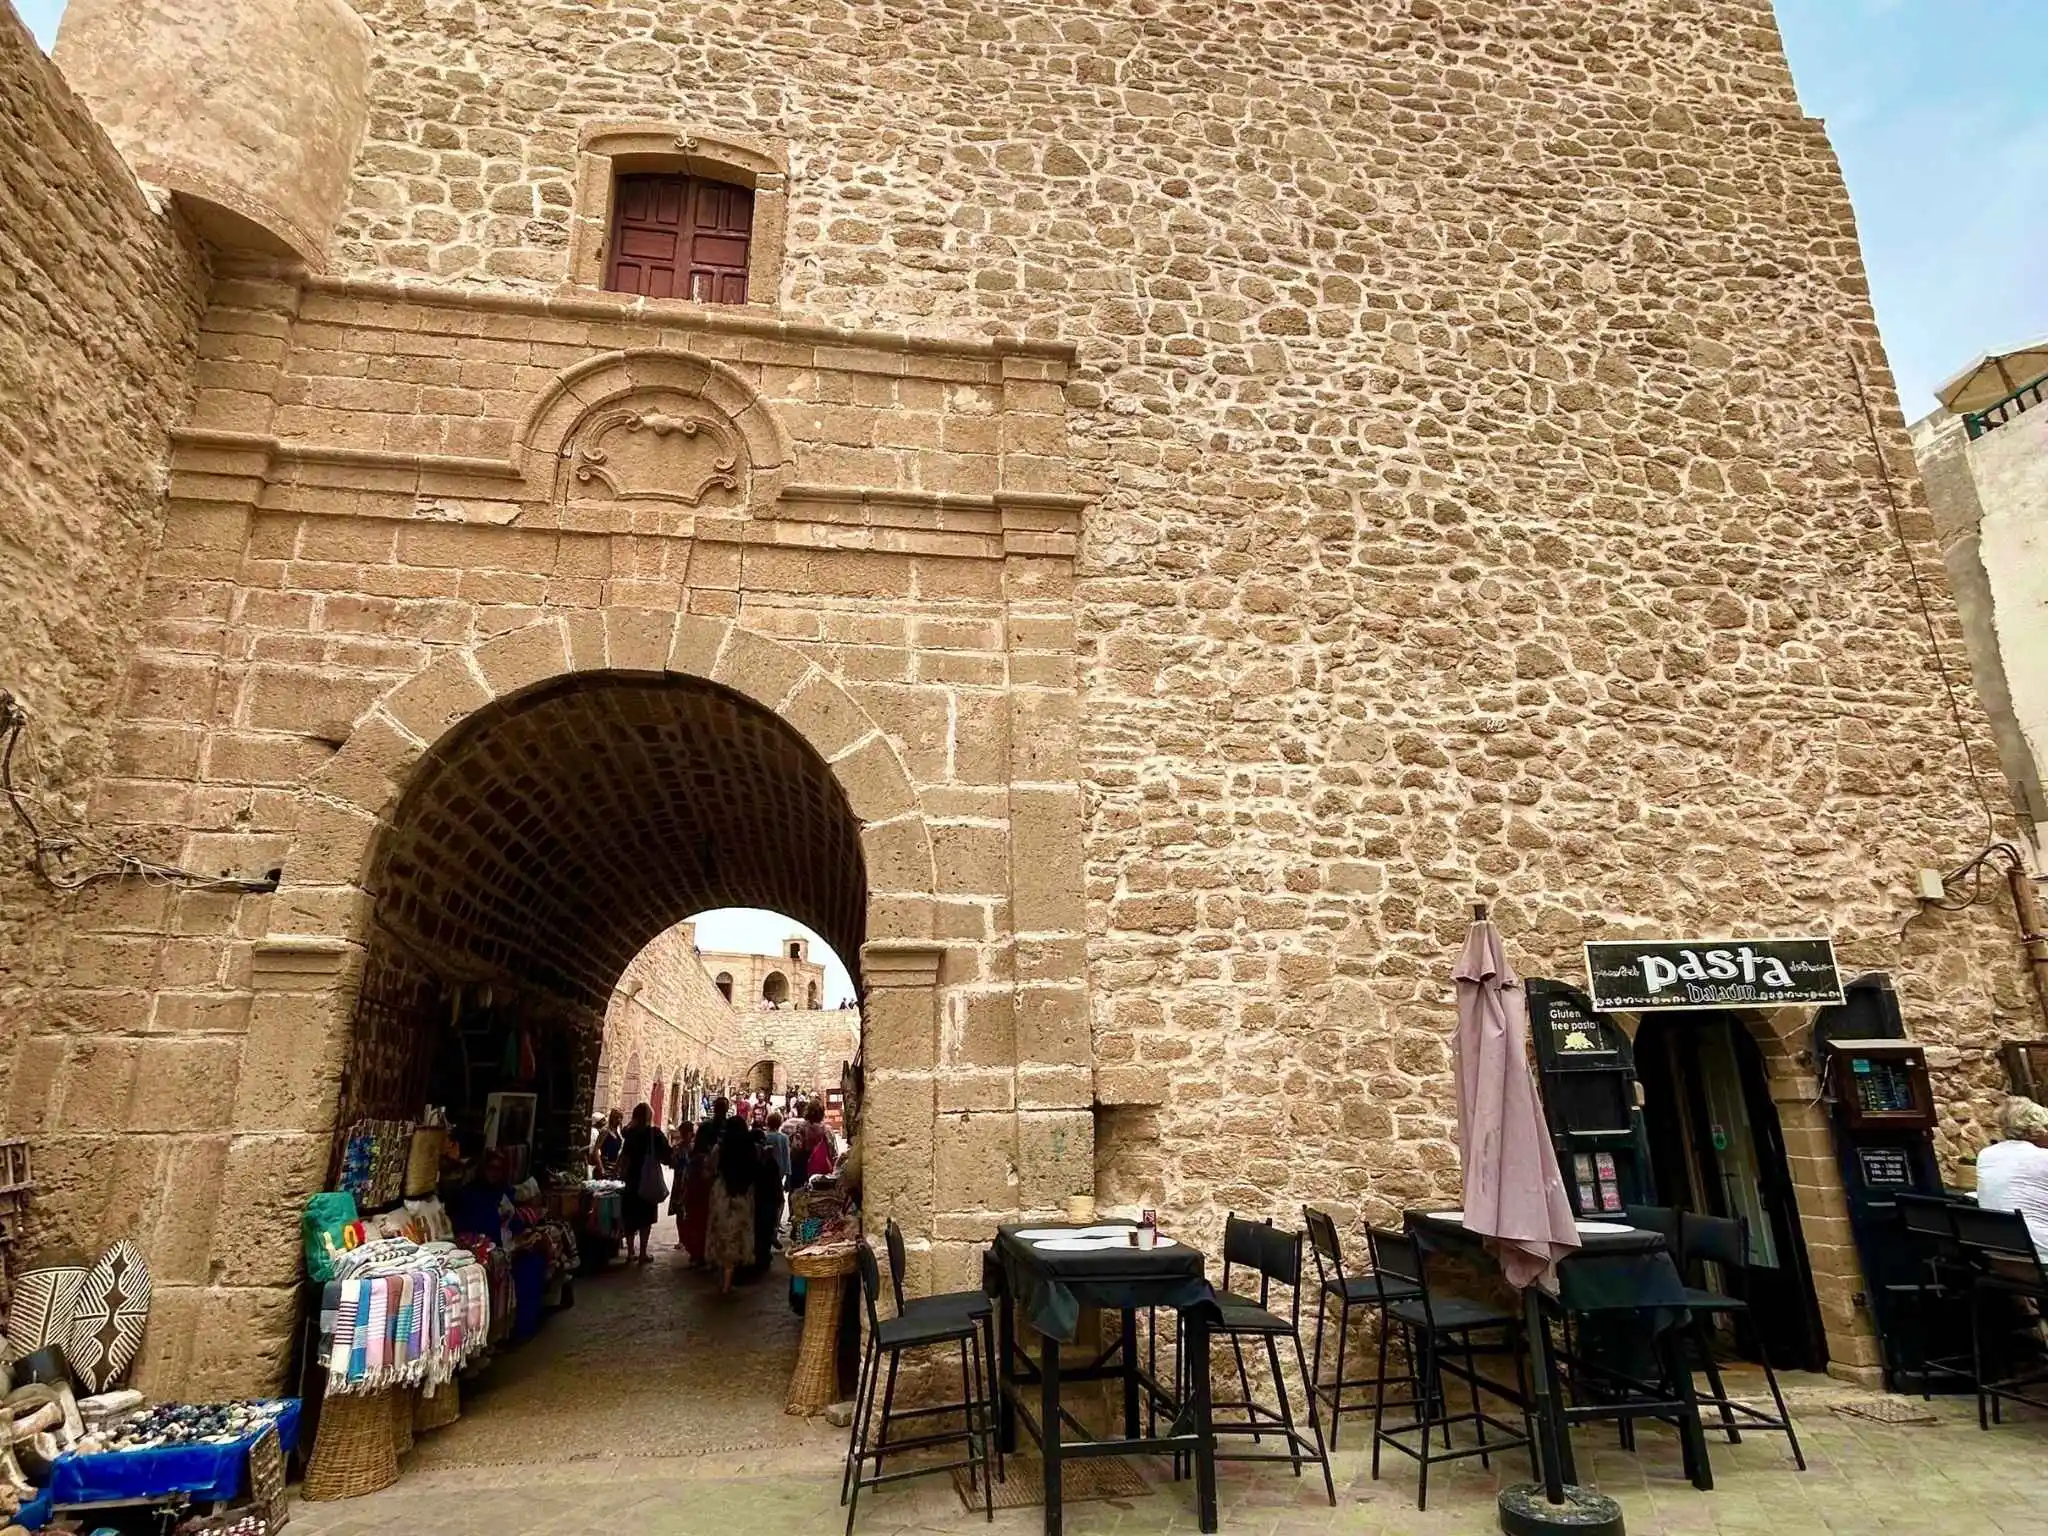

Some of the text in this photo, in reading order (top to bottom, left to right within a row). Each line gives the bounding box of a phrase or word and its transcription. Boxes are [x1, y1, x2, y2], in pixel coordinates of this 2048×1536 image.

[1637, 947, 1796, 994] pasta
[1687, 983, 1757, 1004] baladin
[1549, 1009, 1581, 1019] Gluten
[1551, 1020, 1596, 1031] free pasta
